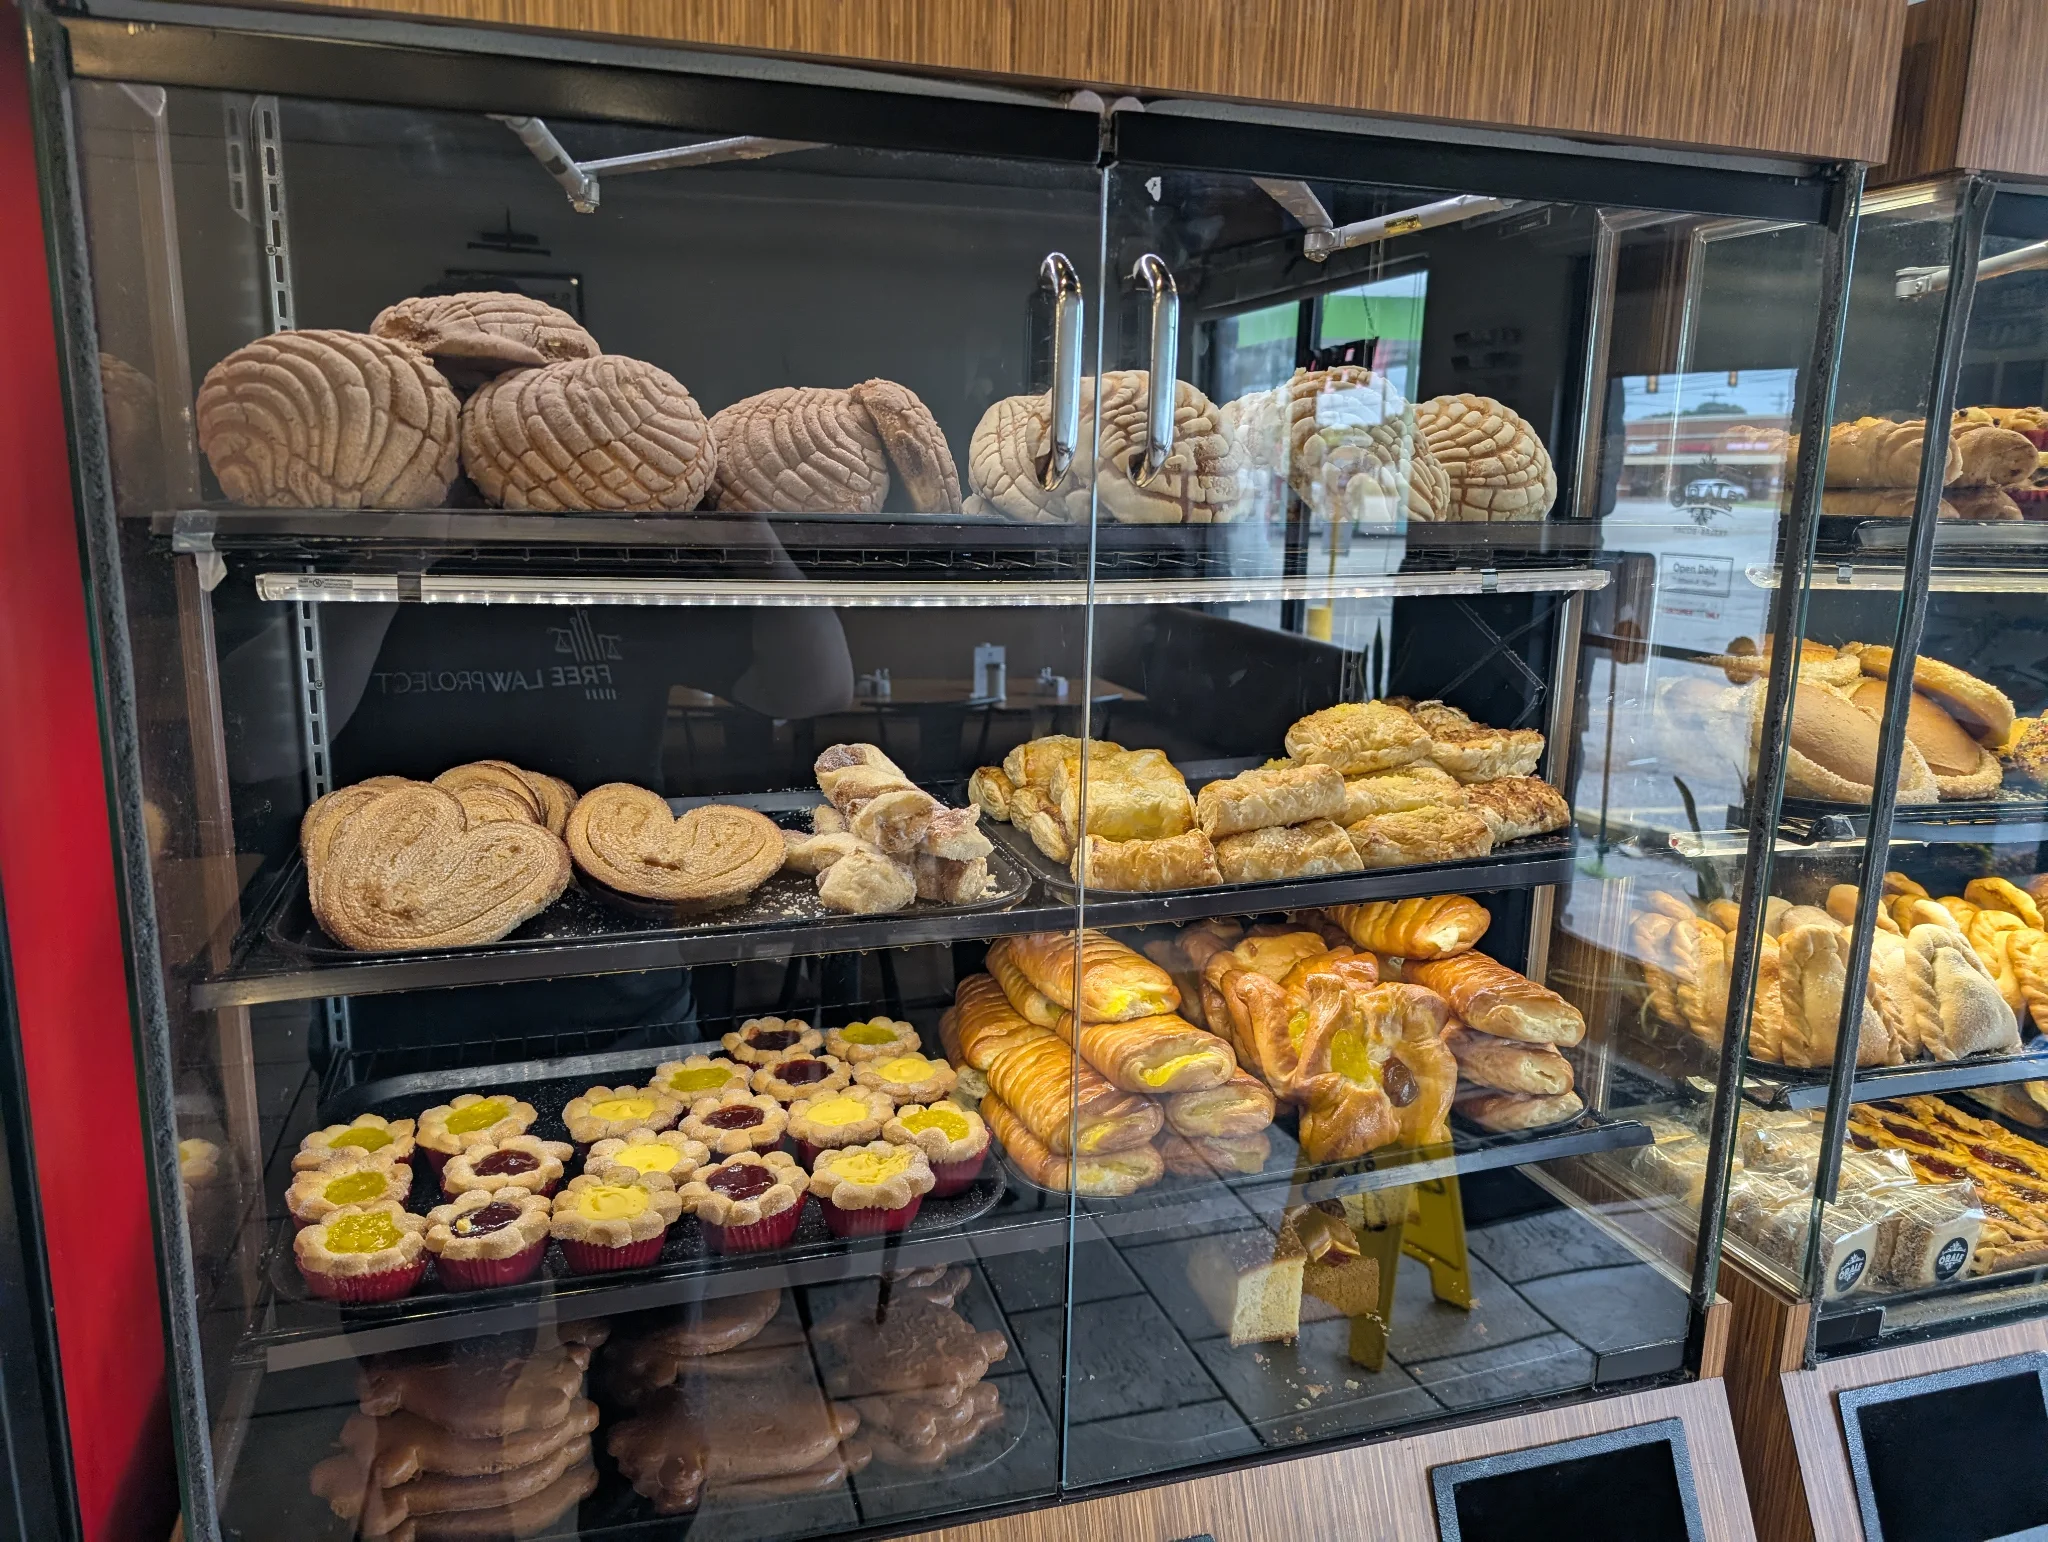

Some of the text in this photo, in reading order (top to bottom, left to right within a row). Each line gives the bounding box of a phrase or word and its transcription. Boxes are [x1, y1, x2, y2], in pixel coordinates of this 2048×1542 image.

[1673, 562, 1719, 577] Open Daily
[1938, 1252, 1965, 1265] ORALE
[1838, 1262, 1863, 1280] ORALE
